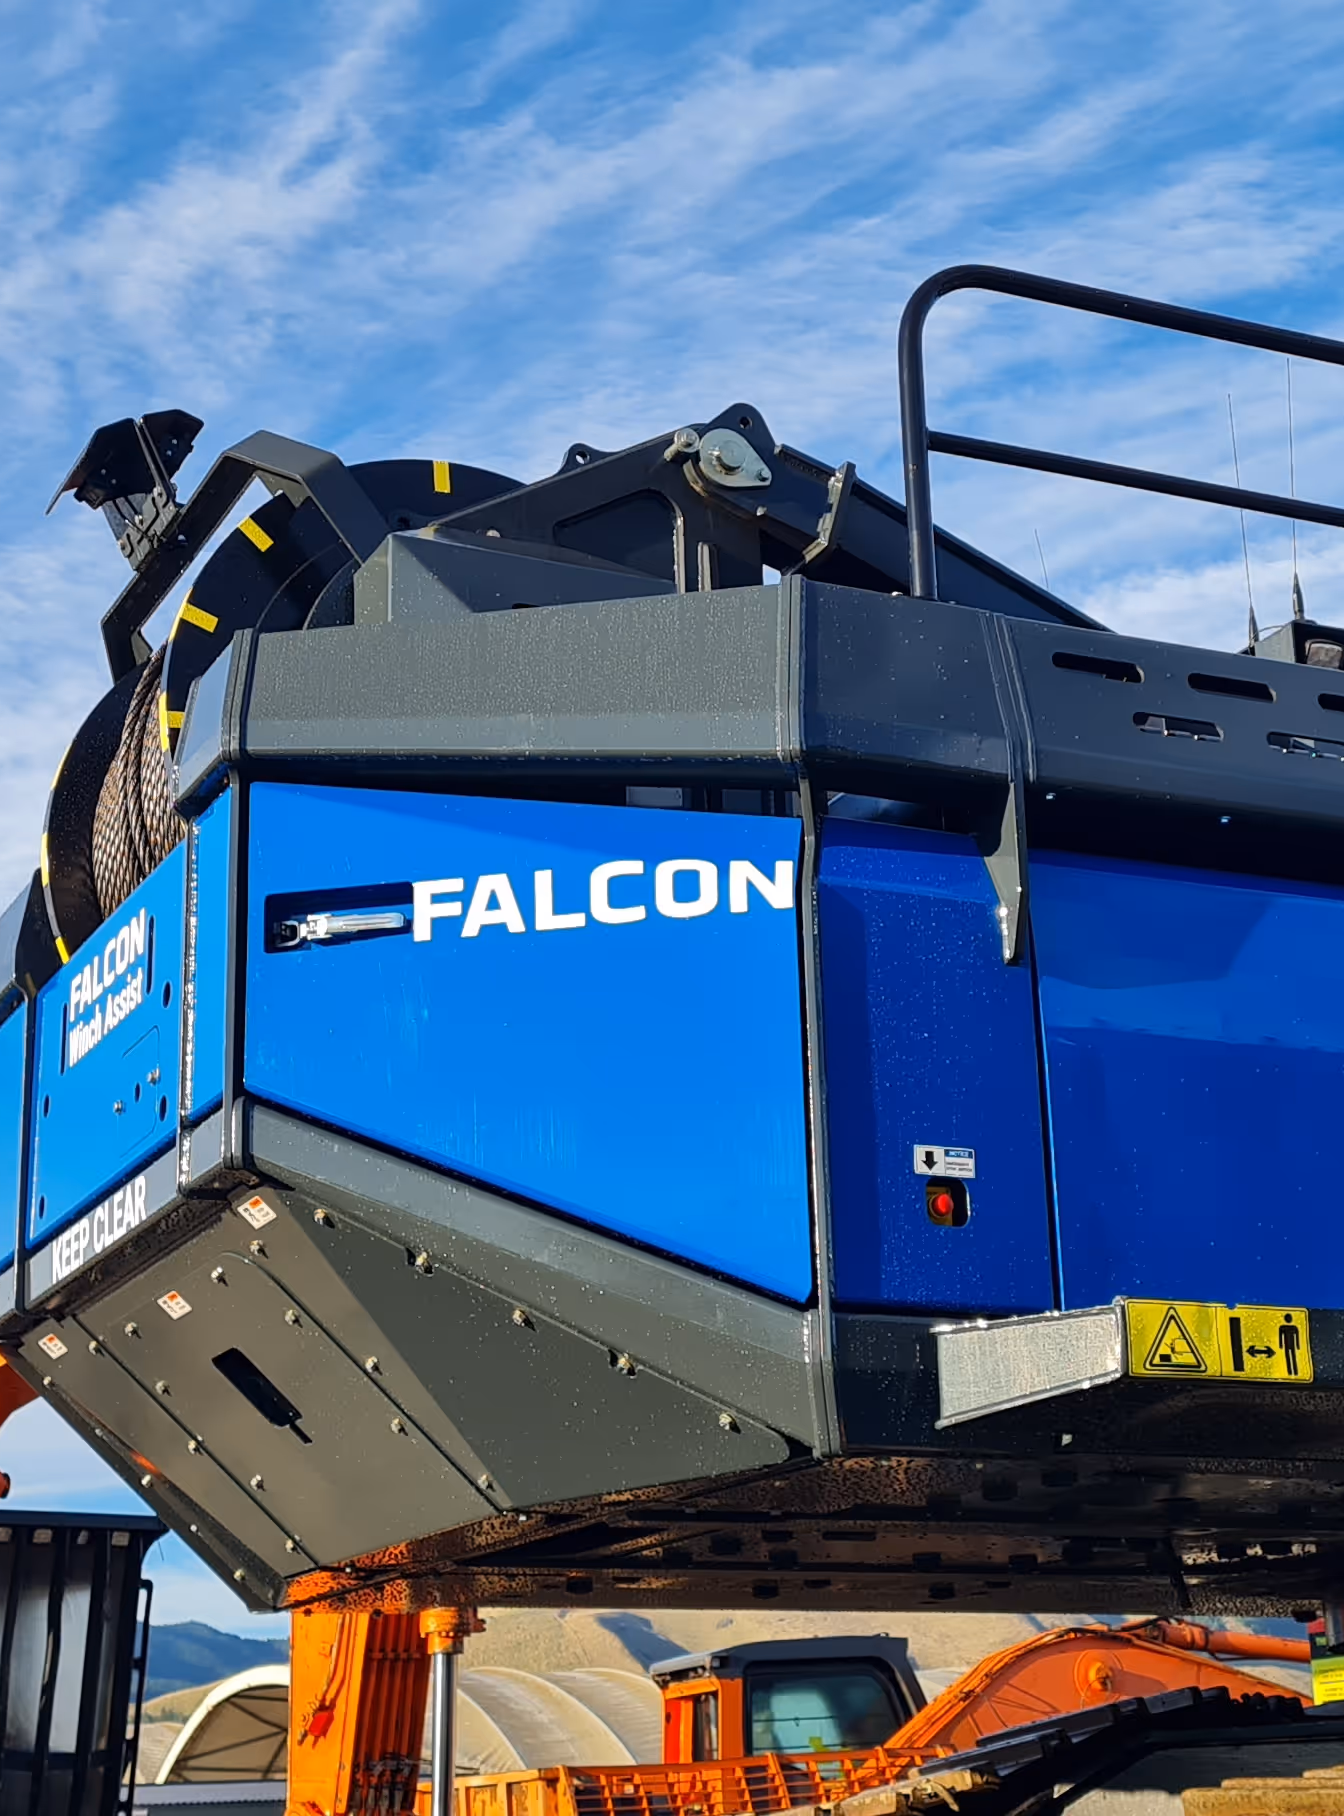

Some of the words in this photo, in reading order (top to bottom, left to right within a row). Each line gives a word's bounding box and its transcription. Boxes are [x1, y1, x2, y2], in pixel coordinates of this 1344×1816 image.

[412, 859, 795, 943] FALCON
[69, 907, 146, 1023] FALCON
[69, 1004, 102, 1068] Winch
[103, 967, 144, 1035] Assist
[52, 1218, 90, 1285] KEEP
[93, 1175, 147, 1254] CLEAR
